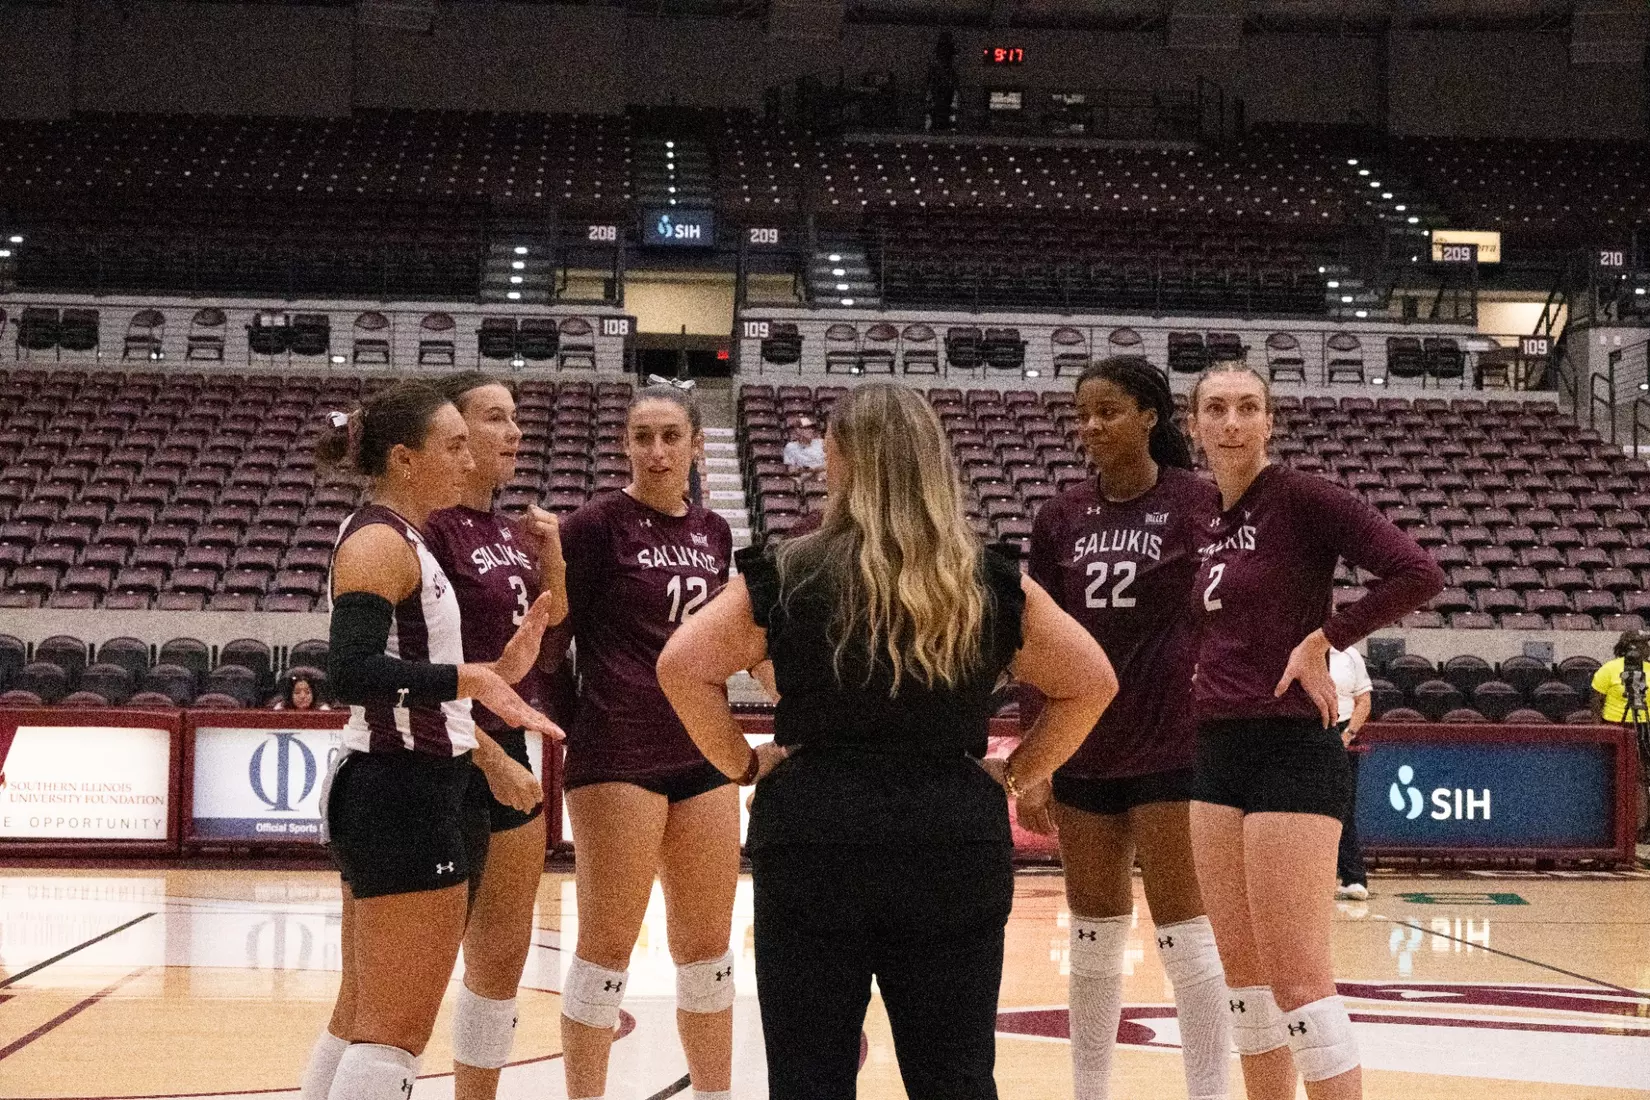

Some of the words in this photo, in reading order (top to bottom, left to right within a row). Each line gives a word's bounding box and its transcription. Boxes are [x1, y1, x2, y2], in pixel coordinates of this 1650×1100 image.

[588, 225, 617, 241] 208
[674, 224, 700, 239] SIH
[750, 228, 778, 243] 209
[1443, 247, 1471, 261] 209
[1600, 251, 1623, 266] 210
[603, 319, 628, 335] 108
[743, 322, 769, 338] 109
[1522, 339, 1548, 355] 109
[1073, 529, 1163, 562] SALUKIS
[637, 544, 719, 575] SALUKIS
[1085, 561, 1137, 609] 22
[1203, 563, 1226, 612] 2
[508, 575, 529, 626] 3
[666, 575, 708, 624] 12
[10, 782, 77, 792] SOUTHERN
[81, 783, 132, 792] ILLINOIS
[10, 794, 82, 804] UNIVERSITY
[85, 795, 164, 805] FOUNDATION
[1431, 787, 1491, 820] SIH
[29, 817, 162, 830] OPPORTUNITY
[256, 822, 287, 832] Official
[289, 823, 318, 834] Sports
